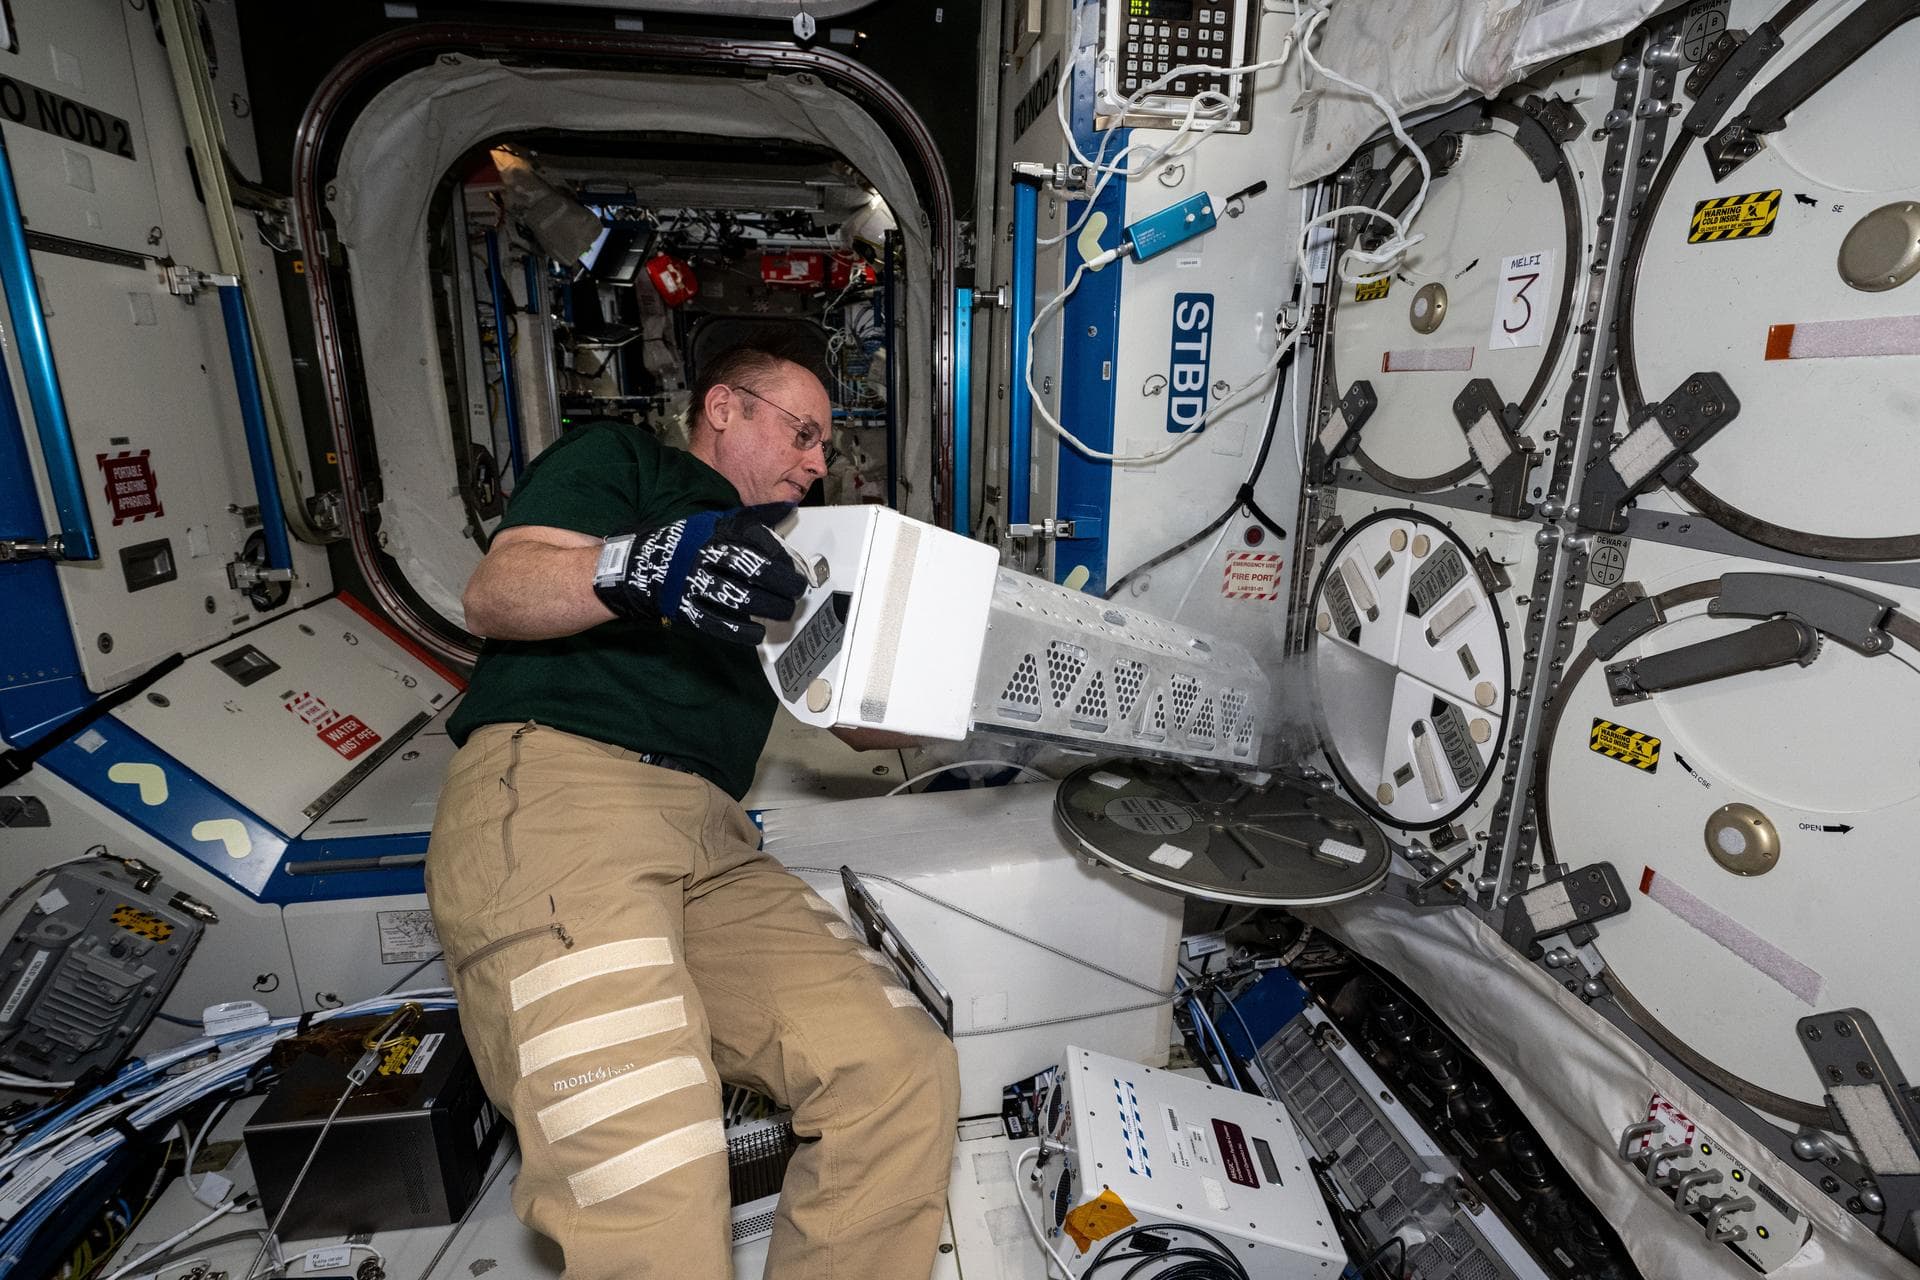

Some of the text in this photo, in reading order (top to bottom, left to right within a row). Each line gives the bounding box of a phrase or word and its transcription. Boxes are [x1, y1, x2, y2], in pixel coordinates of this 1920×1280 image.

[1697, 23, 1703, 33] A
[1712, 17, 1718, 26] B
[34, 88, 106, 150] NOD
[113, 120, 133, 158] 2
[1704, 206, 1741, 218] WARNING
[1702, 217, 1718, 225] COLD
[1719, 213, 1740, 223] INSIDE
[1511, 254, 1541, 269] MELFI
[1503, 273, 1539, 333] 3
[1171, 300, 1210, 426] STBD
[1597, 536, 1622, 547] DEWAR
[1601, 552, 1606, 560] A
[1232, 572, 1274, 581] FIRE PORT
[326, 719, 361, 742] WATER
[1601, 727, 1631, 743] WARNING
[337, 736, 362, 756] MIST
[1600, 733, 1630, 749] COLD INSIDE
[1799, 822, 1821, 832] OPEN
